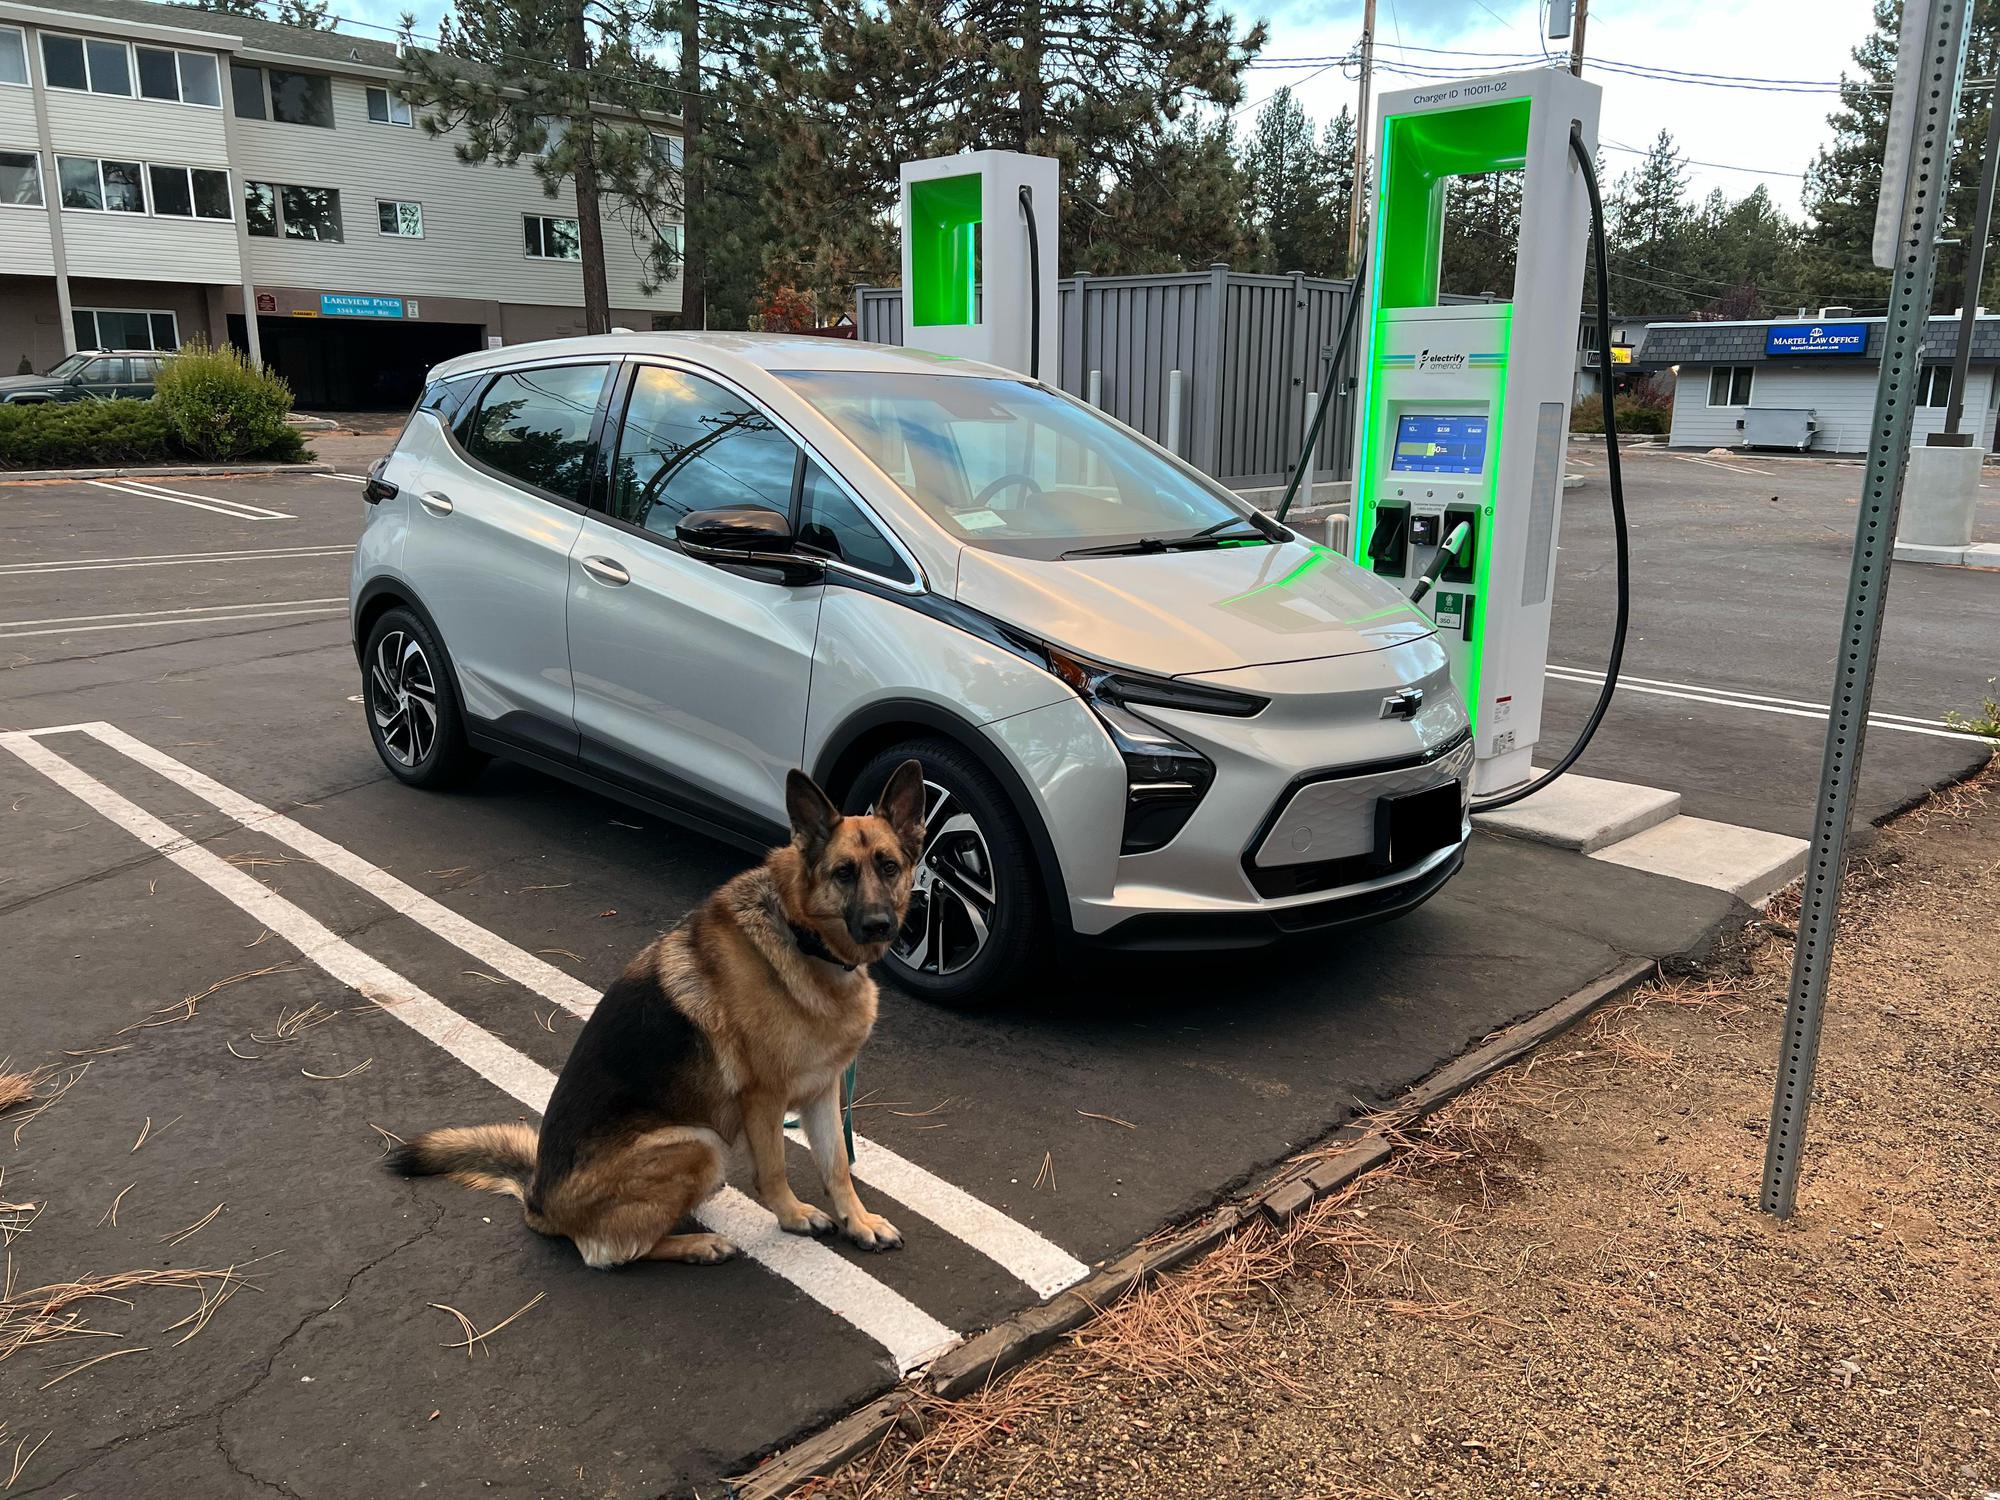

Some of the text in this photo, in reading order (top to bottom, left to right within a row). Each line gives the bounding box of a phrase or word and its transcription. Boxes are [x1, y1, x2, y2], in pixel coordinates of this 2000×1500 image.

[1413, 82, 1507, 104] Charger ID 110011-02
[324, 296, 400, 307] LAKEVIEW PINES
[1773, 336, 1859, 345] MARTEL LAW OFFICE
[1430, 353, 1466, 363] electrify
